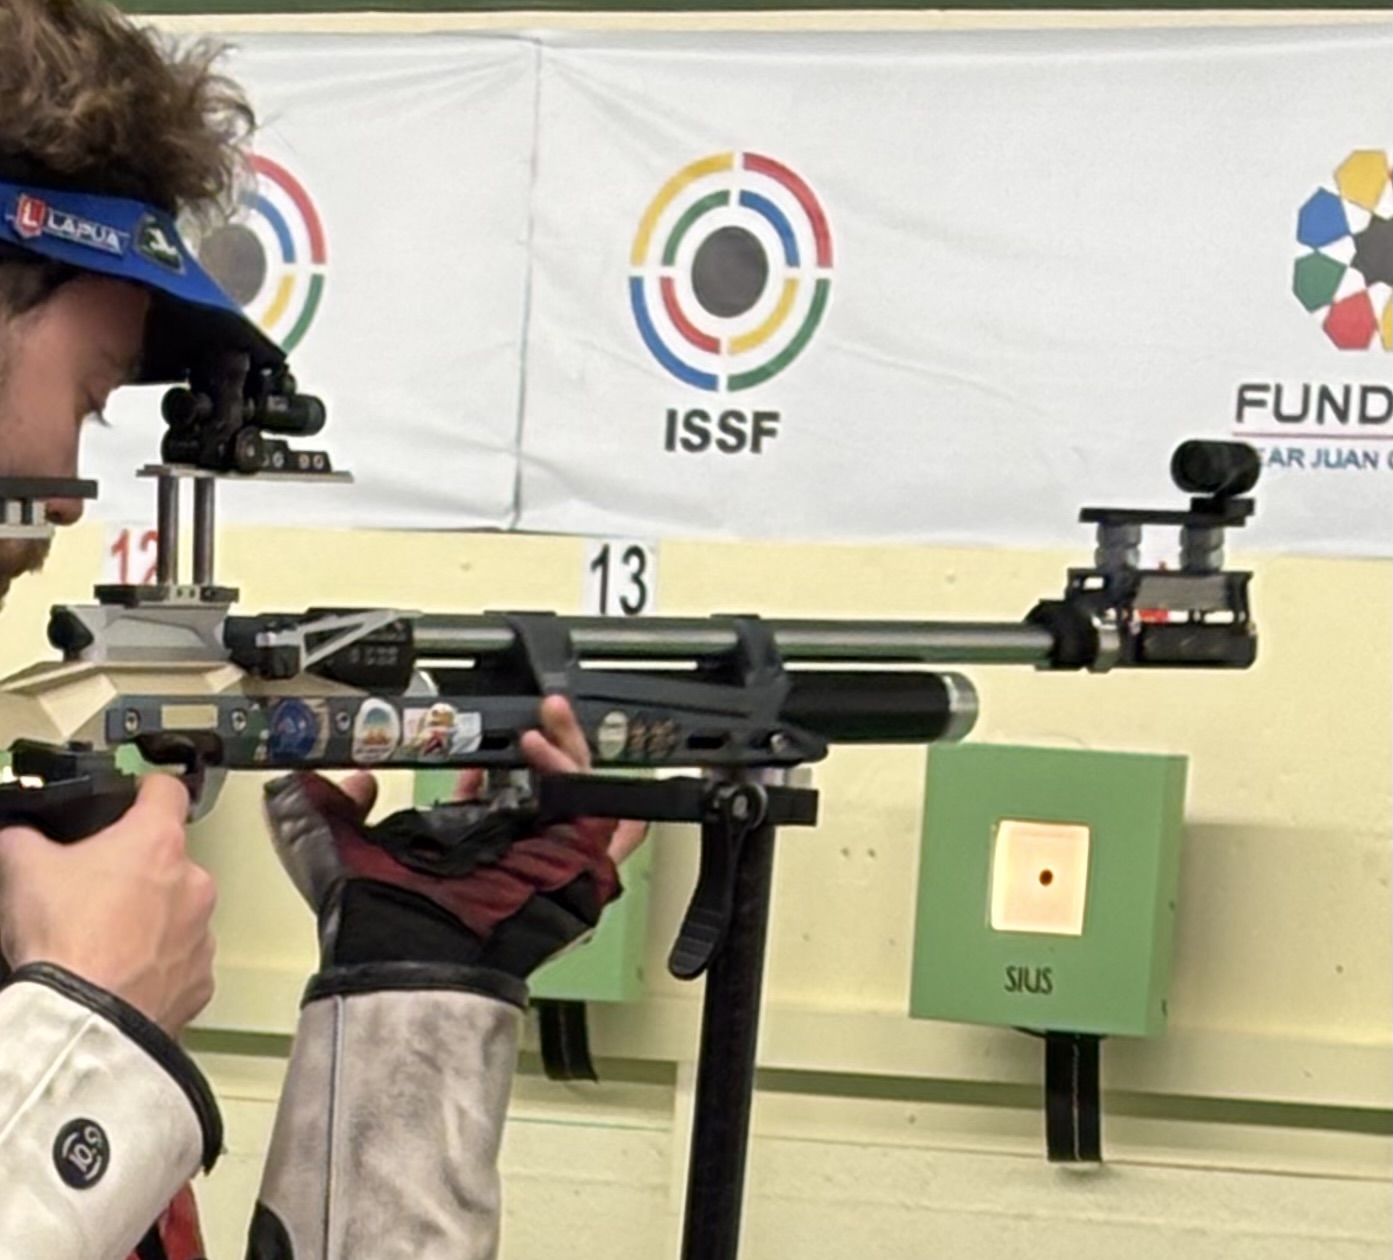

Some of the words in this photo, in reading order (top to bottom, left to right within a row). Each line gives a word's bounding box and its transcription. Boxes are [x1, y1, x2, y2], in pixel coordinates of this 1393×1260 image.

[47, 206, 123, 256] LAPUA
[1235, 383, 1393, 425] FUND
[665, 408, 781, 455] ISSF
[1310, 448, 1379, 470] JUAN
[590, 543, 648, 616] 13
[1004, 965, 1053, 996] SIUS
